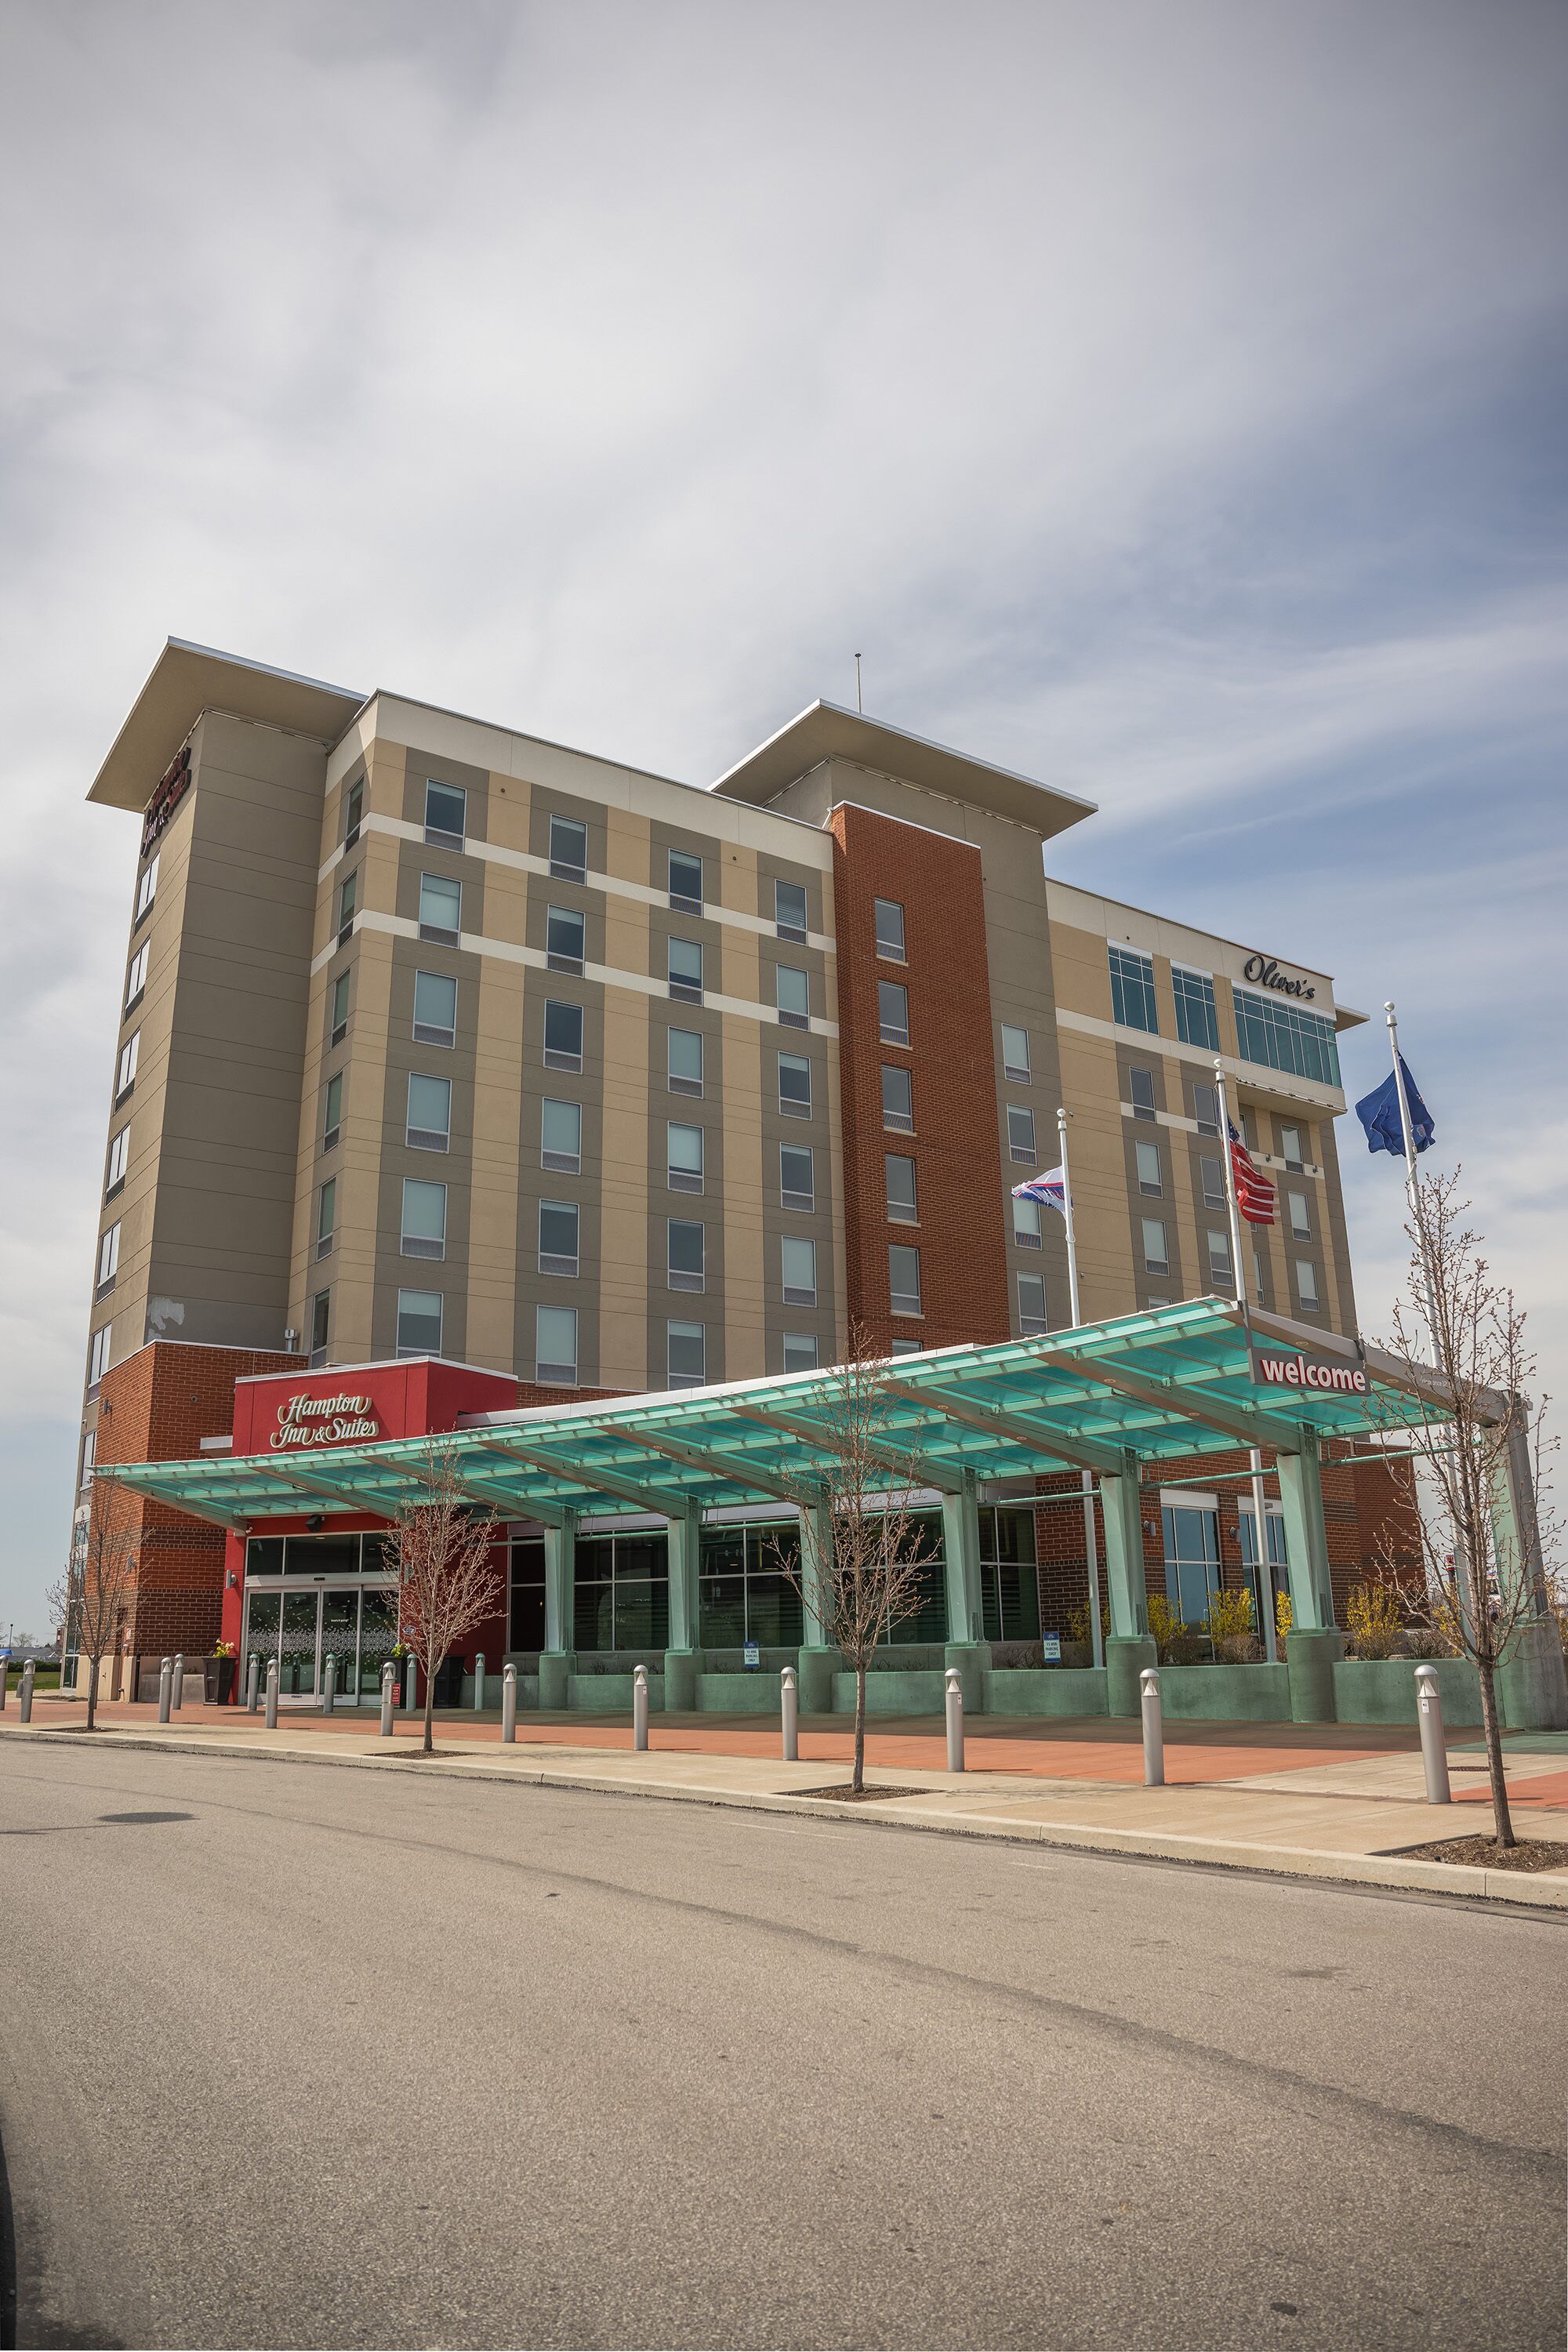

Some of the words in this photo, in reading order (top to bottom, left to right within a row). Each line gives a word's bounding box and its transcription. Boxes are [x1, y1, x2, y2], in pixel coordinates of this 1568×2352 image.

[1244, 955, 1316, 1000] Oliver's
[1261, 1356, 1366, 1392] welcome
[277, 1392, 372, 1425] Hampton
[270, 1423, 318, 1449] Inn
[314, 1426, 330, 1444] &
[325, 1417, 379, 1441] Suites
